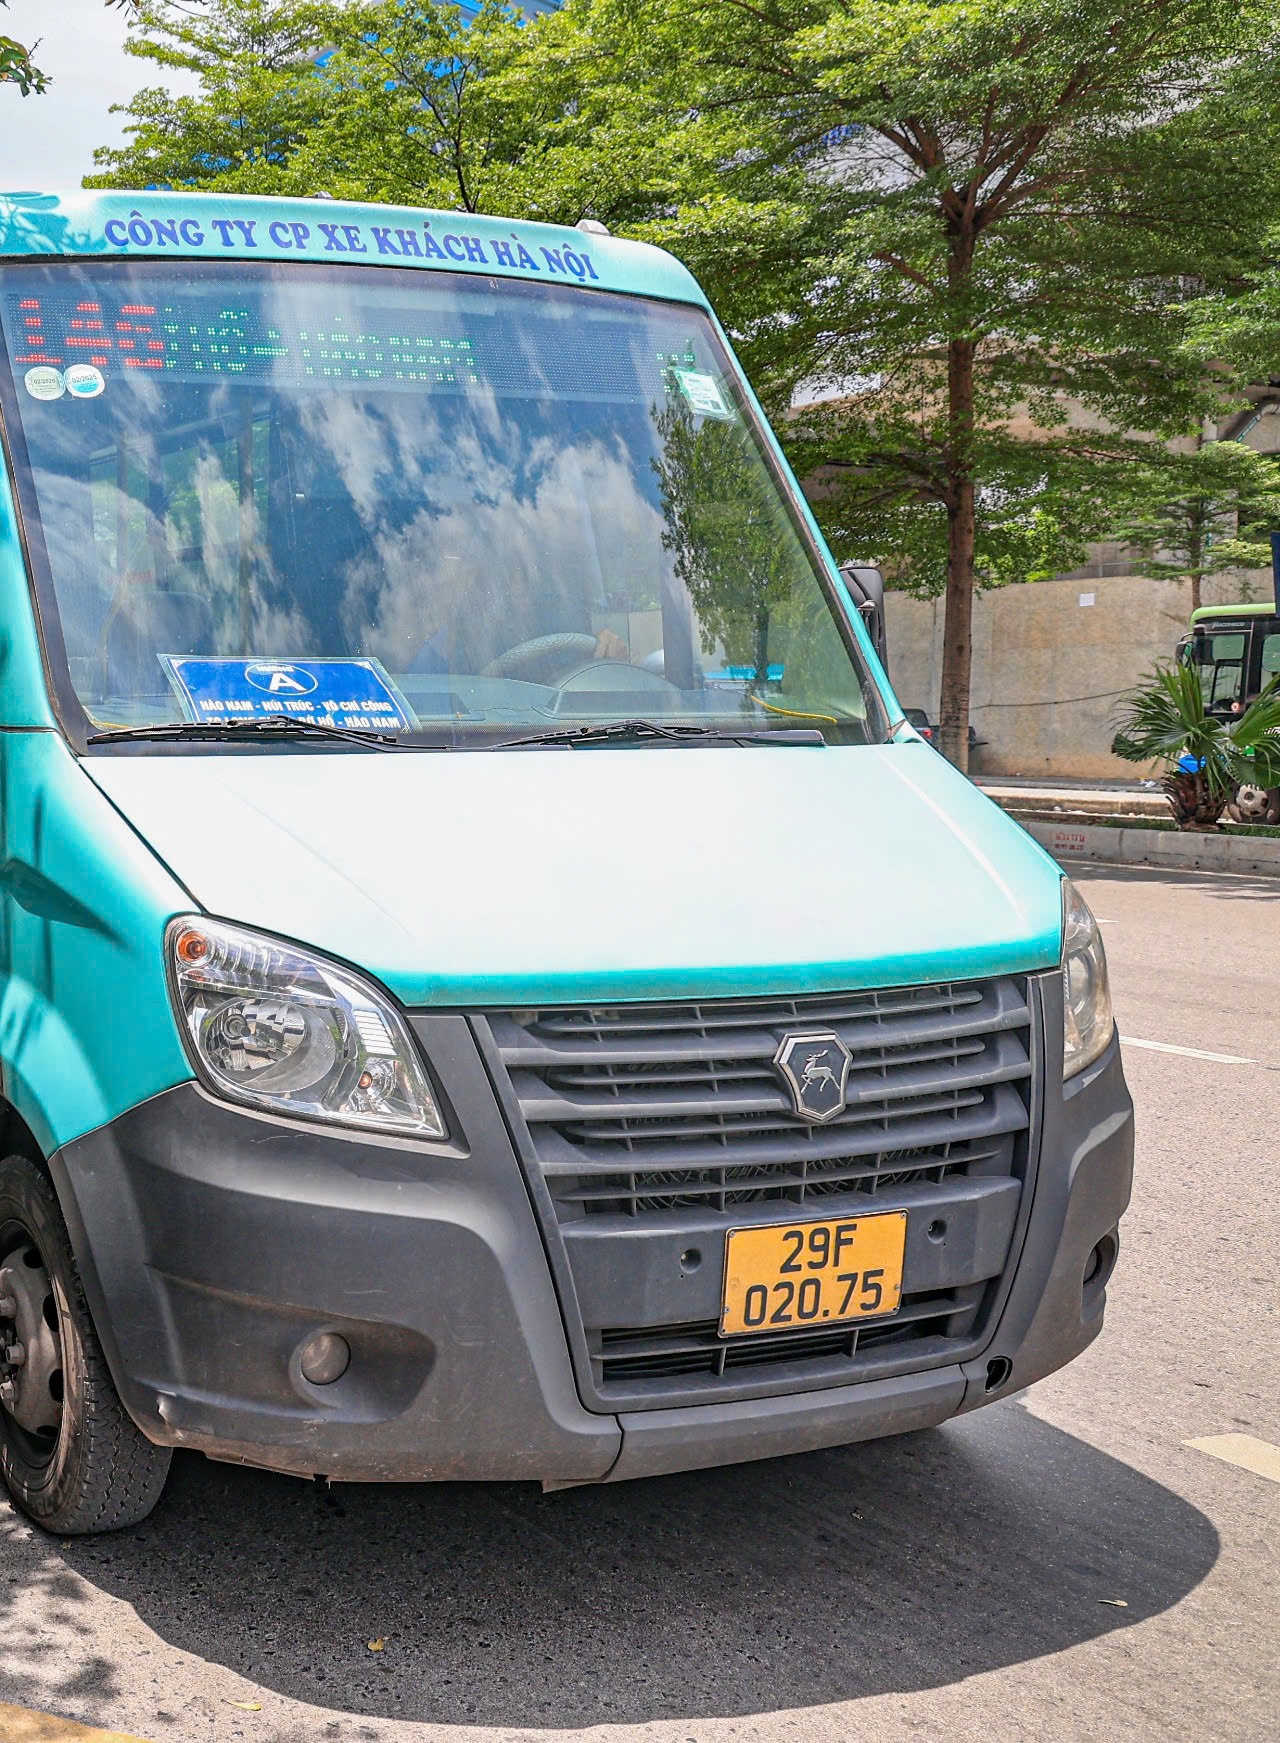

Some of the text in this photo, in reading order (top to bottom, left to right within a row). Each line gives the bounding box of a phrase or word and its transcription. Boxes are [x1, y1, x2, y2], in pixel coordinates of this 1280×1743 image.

[104, 209, 599, 282] CÔNG TY CP XE KHÁCH HÀ NỘI
[269, 672, 307, 691] A
[200, 698, 225, 711] HÀO
[224, 700, 254, 711] NAM
[261, 699, 284, 711] NÚI
[282, 699, 315, 711] TRÚC
[339, 699, 361, 711] CHÍ
[360, 699, 394, 712] CÔNG
[343, 714, 371, 728] HÀO
[370, 716, 401, 728] NAM
[779, 1223, 858, 1274] 29F
[743, 1268, 885, 1327] 020.75
